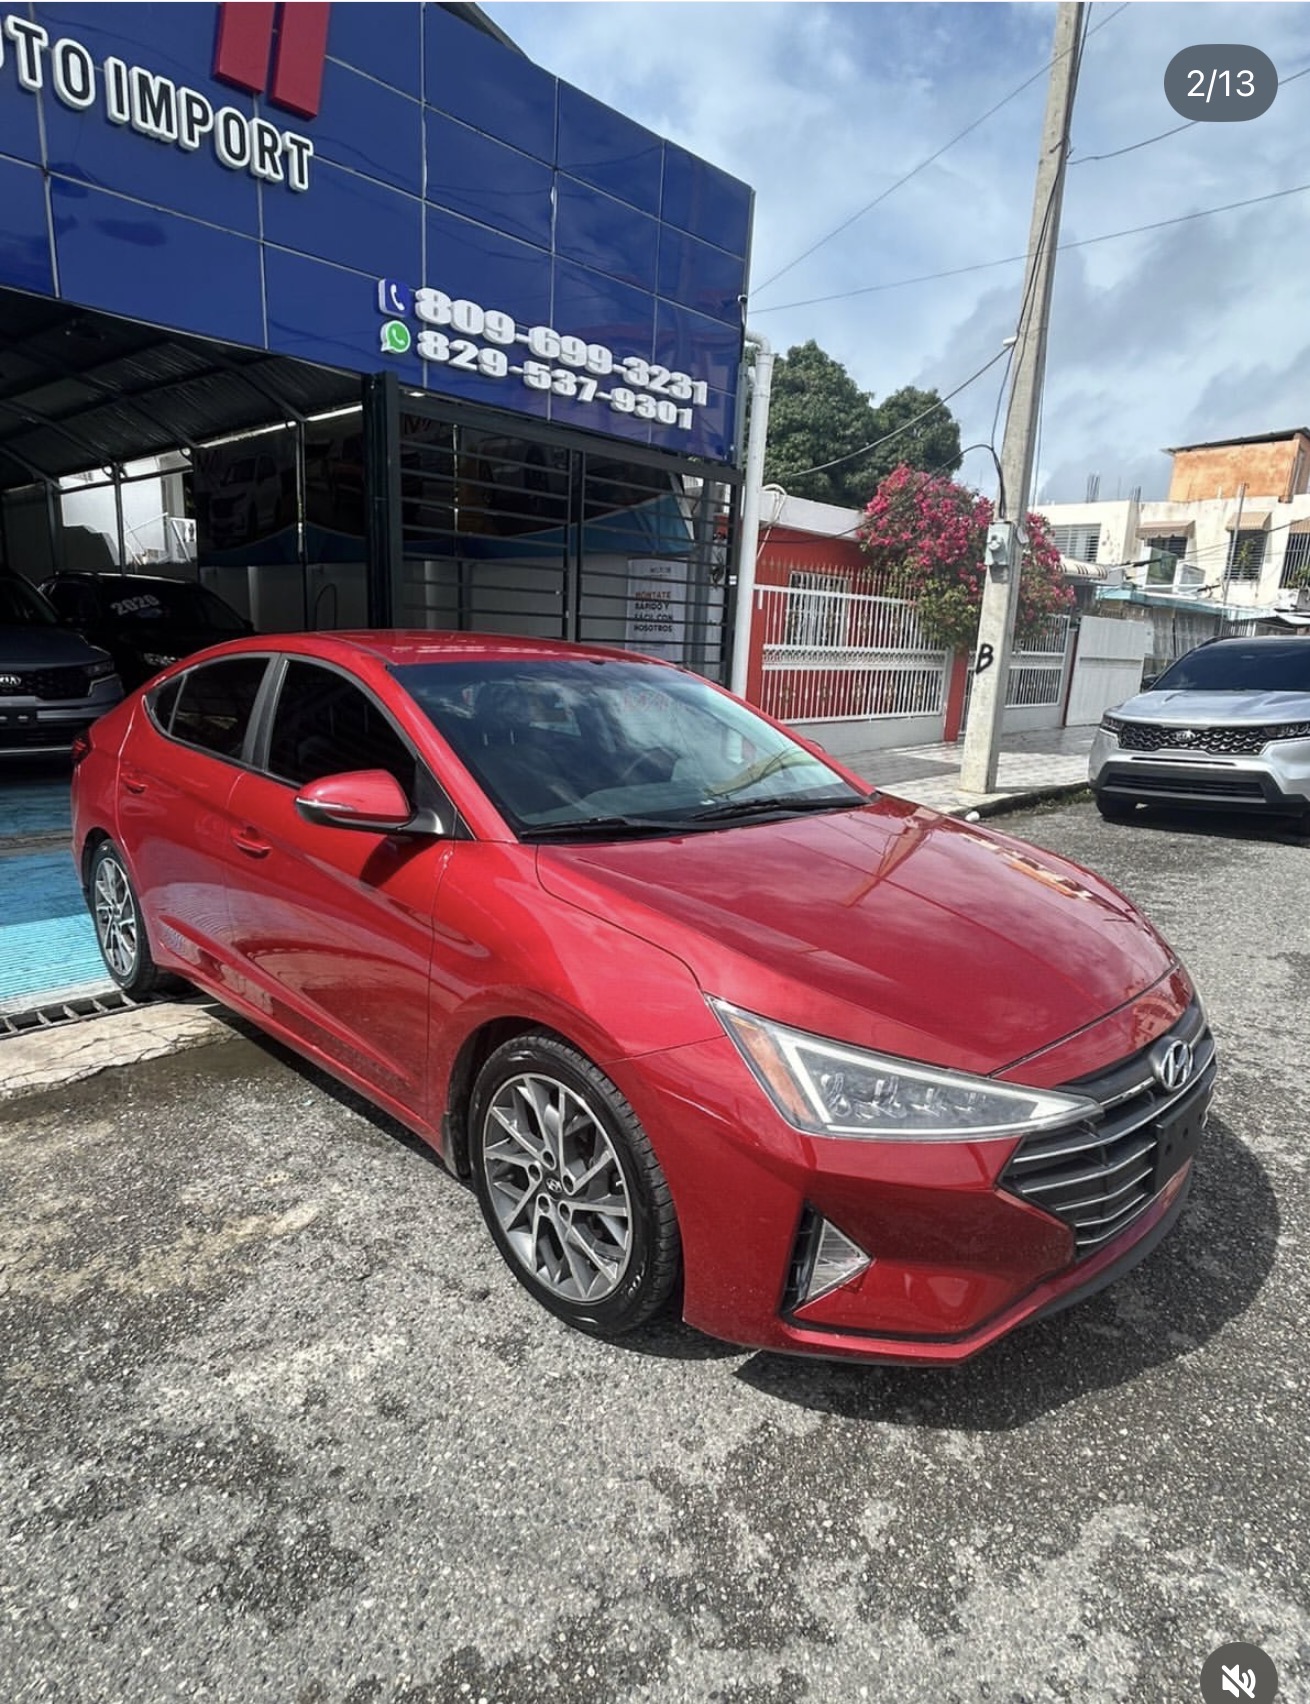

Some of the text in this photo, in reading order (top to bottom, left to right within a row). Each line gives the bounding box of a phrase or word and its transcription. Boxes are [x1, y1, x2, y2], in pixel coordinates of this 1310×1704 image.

[0, 15, 313, 191] TO IMPORT
[415, 287, 708, 407] 809-699-3231
[417, 330, 693, 430] 829-537-9301
[110, 594, 161, 616] 2020
[976, 643, 994, 675] B
